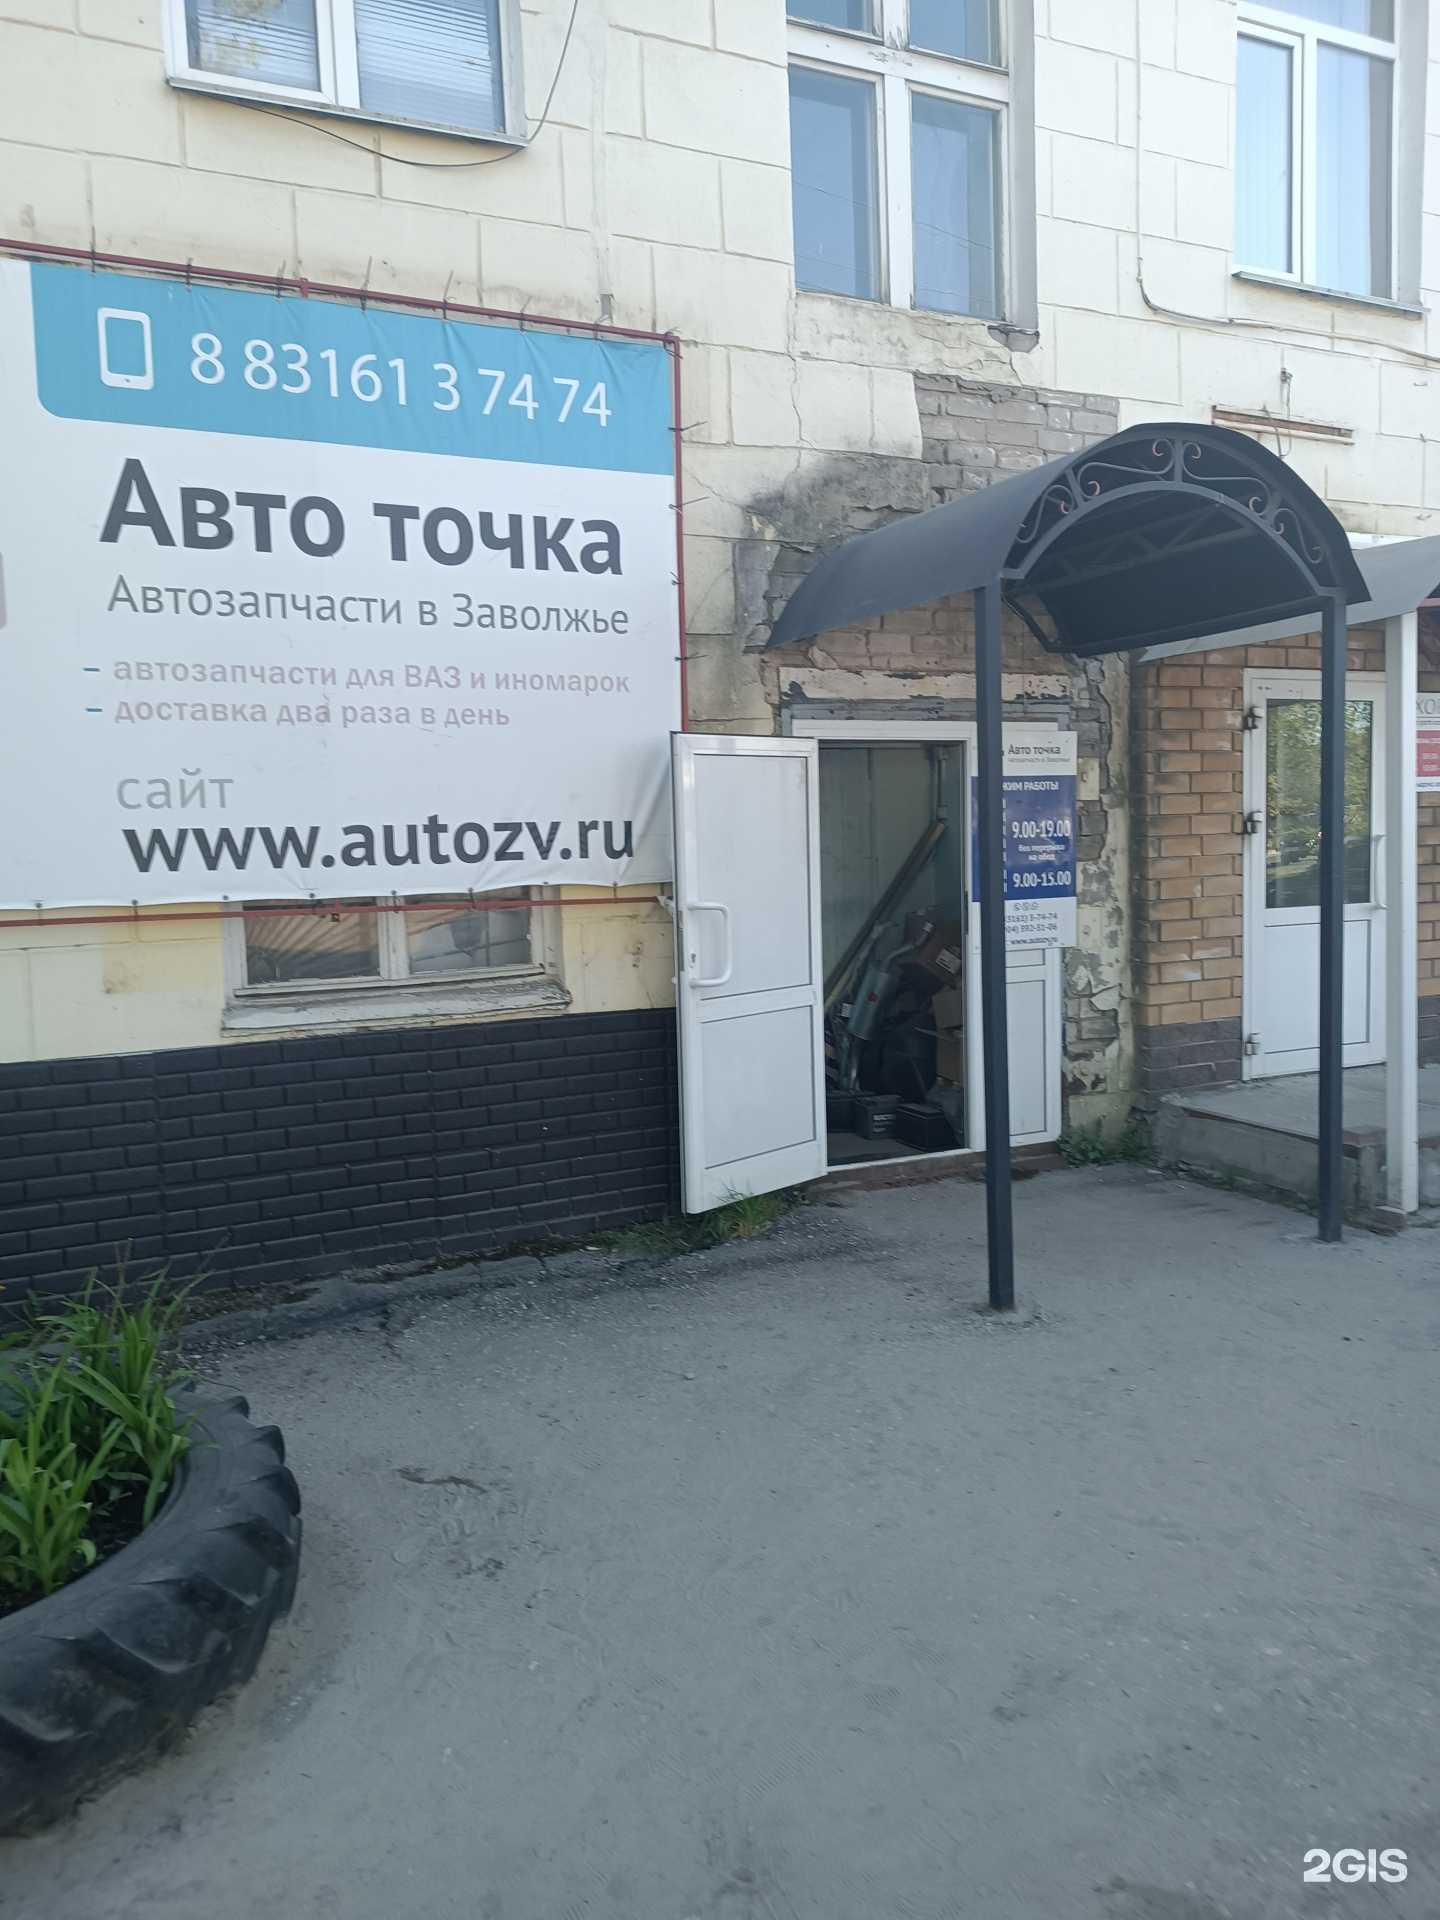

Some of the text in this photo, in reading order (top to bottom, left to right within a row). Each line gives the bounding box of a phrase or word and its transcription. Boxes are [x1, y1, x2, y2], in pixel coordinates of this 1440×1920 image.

[191, 332, 612, 427] 8 83161 3 74 74
[99, 457, 624, 576] Авто точка
[107, 573, 629, 634] Автозапчасти в Заволжье
[113, 660, 630, 696] автозапчасти для ВАЗ и иномарок
[114, 700, 510, 728] доставка два раза в день
[1008, 744, 1031, 755] Авто
[116, 767, 235, 809] сайт
[1024, 781, 1060, 791] РАБОТЫ
[122, 813, 635, 873] www.autozv.ru
[1012, 820, 1072, 838] 9.00-19.00
[1012, 870, 1072, 888] 9.00-15.00
